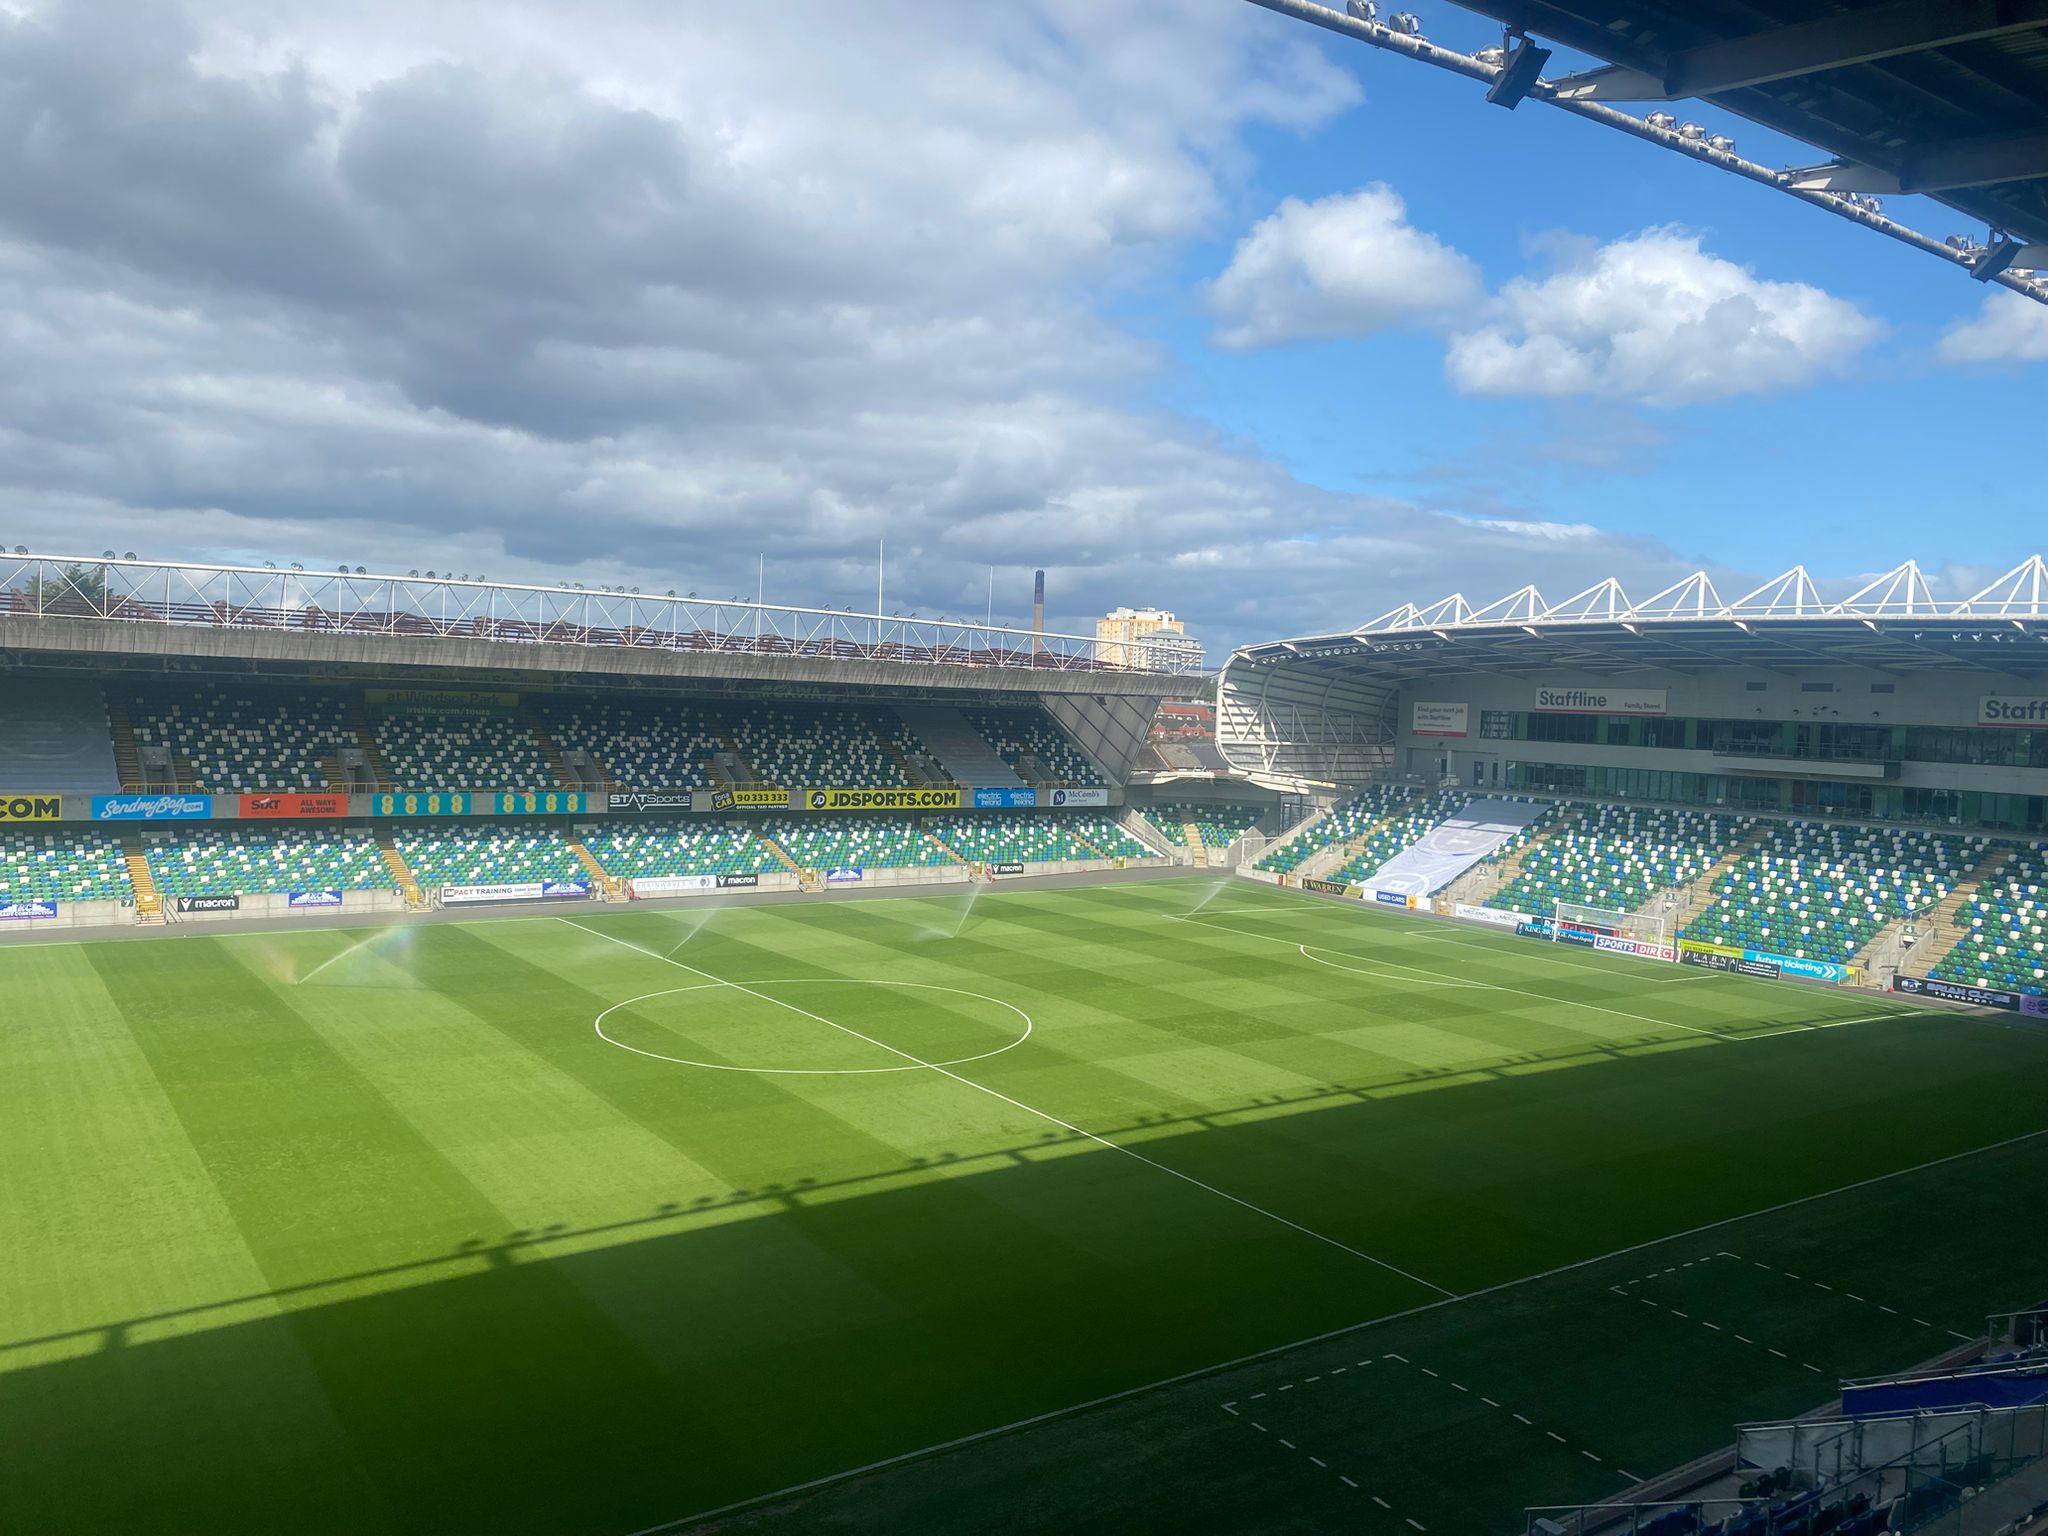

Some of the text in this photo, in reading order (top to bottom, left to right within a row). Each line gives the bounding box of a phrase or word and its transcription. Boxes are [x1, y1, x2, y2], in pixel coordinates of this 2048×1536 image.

[1540, 690, 1607, 706] Staffline
[1985, 699, 2048, 720] Staff
[610, 793, 690, 804] STATSports
[737, 793, 788, 802] 90 333 333
[813, 795, 825, 805] JD
[830, 792, 956, 807] JDSPORTS.COM
[977, 791, 1001, 799] electric
[1010, 791, 1034, 799] electric
[101, 797, 185, 818] SendmyBag
[251, 799, 280, 810] SIXT
[715, 798, 732, 809] CAB
[301, 806, 336, 814] AWESOME
[1000, 864, 1022, 872] macron
[728, 876, 755, 885] macron
[476, 887, 513, 895] TRAINING
[1310, 881, 1342, 893] WARREN
[195, 898, 235, 908] macron
[1377, 893, 1405, 904] USED CARS
[1598, 937, 1635, 952] SPORTS
[1639, 945, 1675, 959] DIRECT
[1755, 953, 1783, 967] future
[1784, 959, 1823, 975] ticketing
[1927, 983, 1966, 996] BRIAN
[1935, 991, 1994, 1005] TRANSPORT
